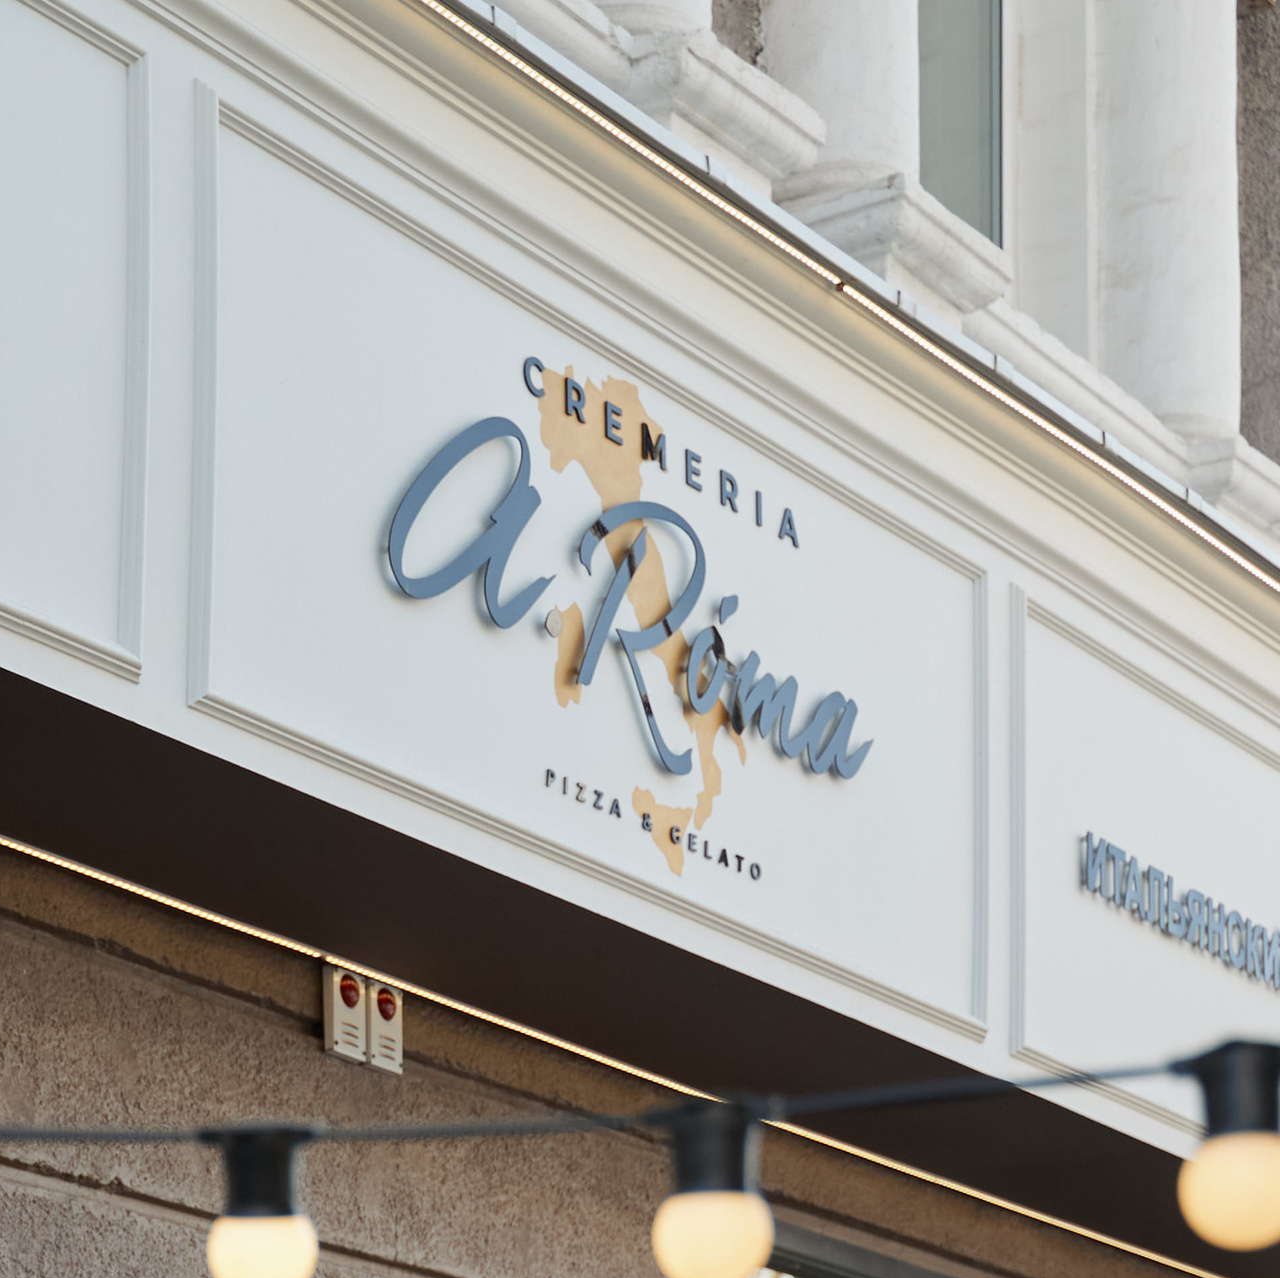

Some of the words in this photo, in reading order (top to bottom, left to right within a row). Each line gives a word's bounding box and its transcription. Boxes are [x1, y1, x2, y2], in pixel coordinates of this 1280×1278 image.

[523, 356, 800, 548] CREMERIA
[545, 769, 622, 819] PIZZA
[640, 812, 654, 833] &
[669, 826, 763, 882] GELATO
